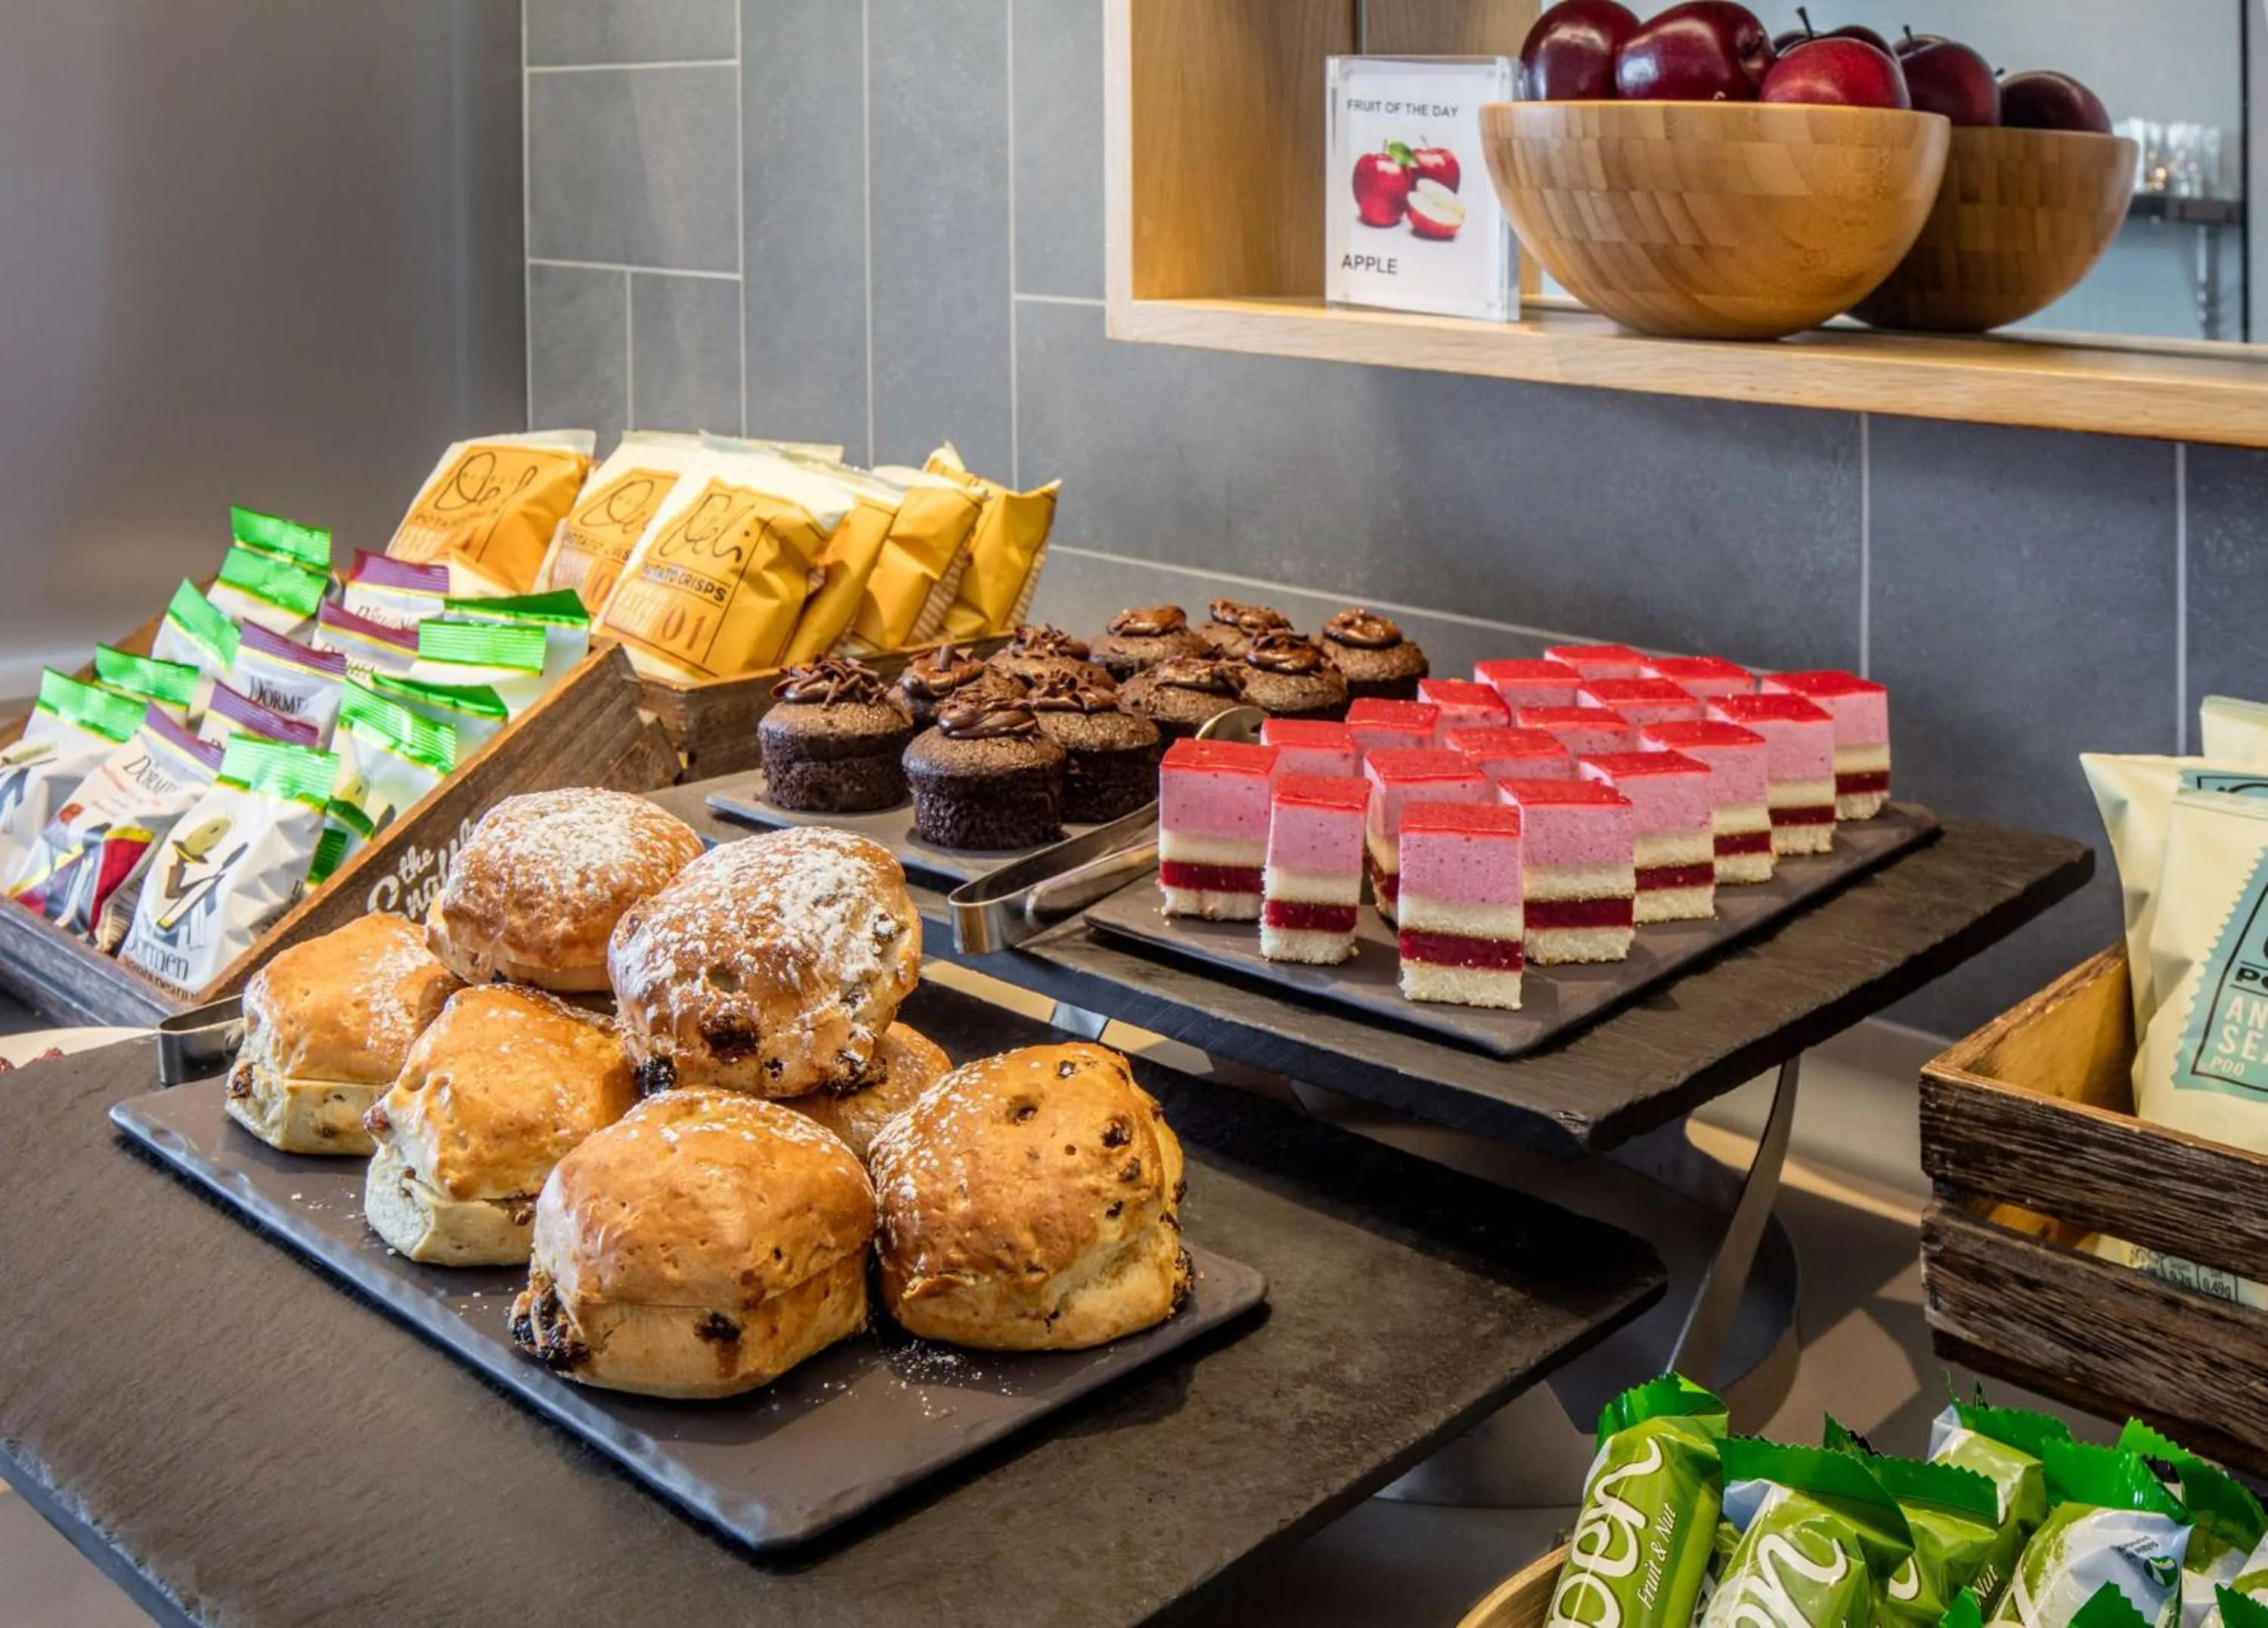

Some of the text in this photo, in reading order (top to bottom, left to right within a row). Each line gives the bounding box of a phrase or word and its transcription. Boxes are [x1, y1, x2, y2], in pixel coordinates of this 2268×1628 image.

[1346, 99, 1460, 118] FRUIT OF THE DAY
[1341, 254, 1398, 275] APPLE
[677, 572, 727, 602] CRISPS
[661, 604, 707, 651] 01
[398, 844, 436, 884] the
[2217, 1024, 2268, 1066] SE
[1637, 1502, 1676, 1611] Fruit & Nut
